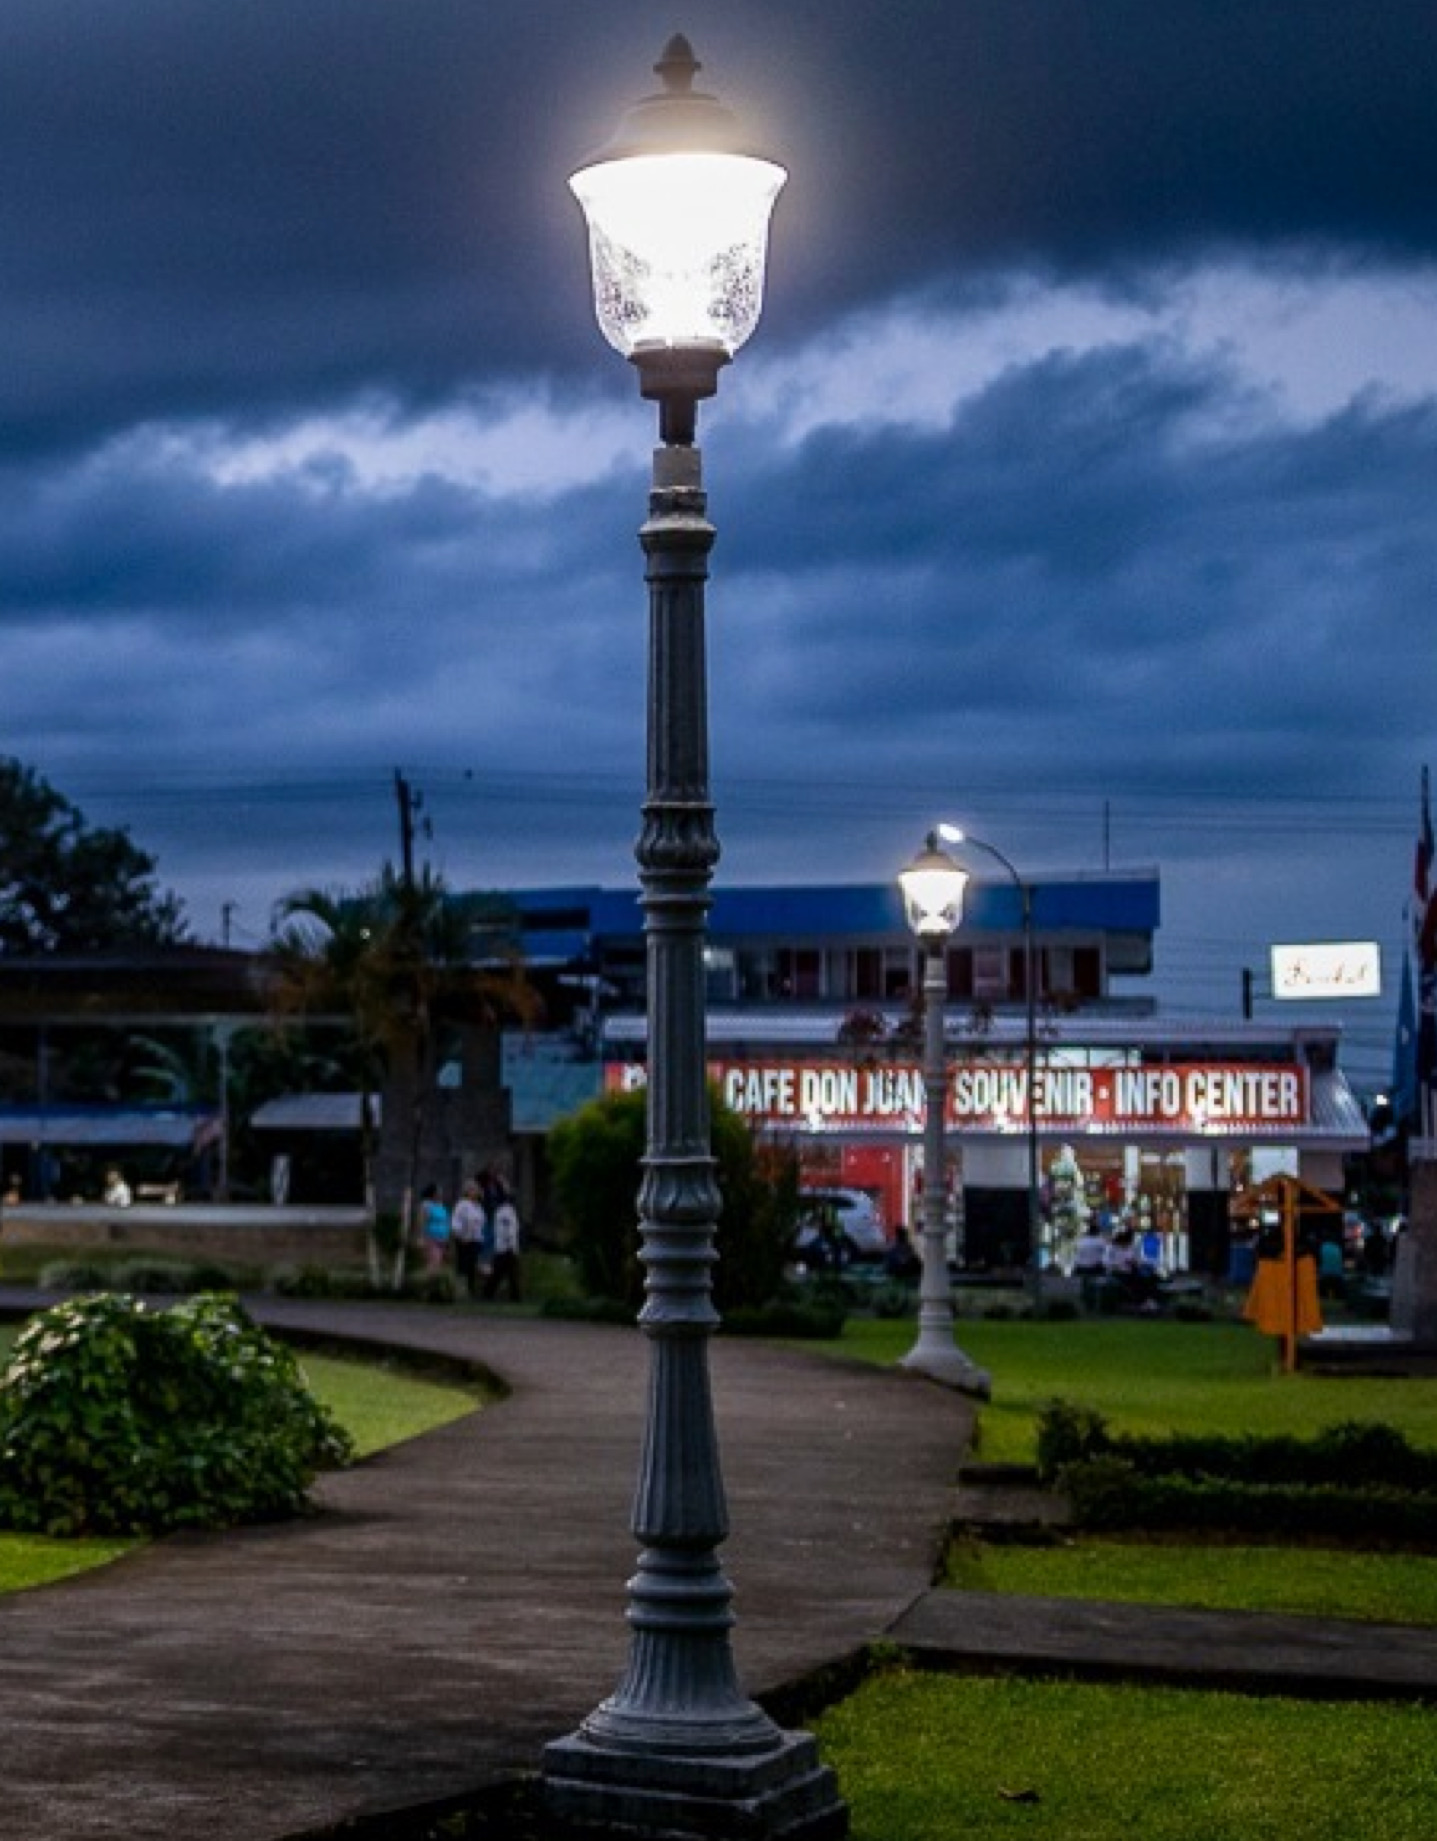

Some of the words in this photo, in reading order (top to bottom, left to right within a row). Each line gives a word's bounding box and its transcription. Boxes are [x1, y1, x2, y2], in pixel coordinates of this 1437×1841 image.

[725, 1068, 794, 1113] CAFE
[802, 1069, 857, 1114] DON
[955, 1069, 1094, 1115] SOUVENIR
[1115, 1071, 1180, 1116] INFO
[1186, 1071, 1299, 1117] CENTER
